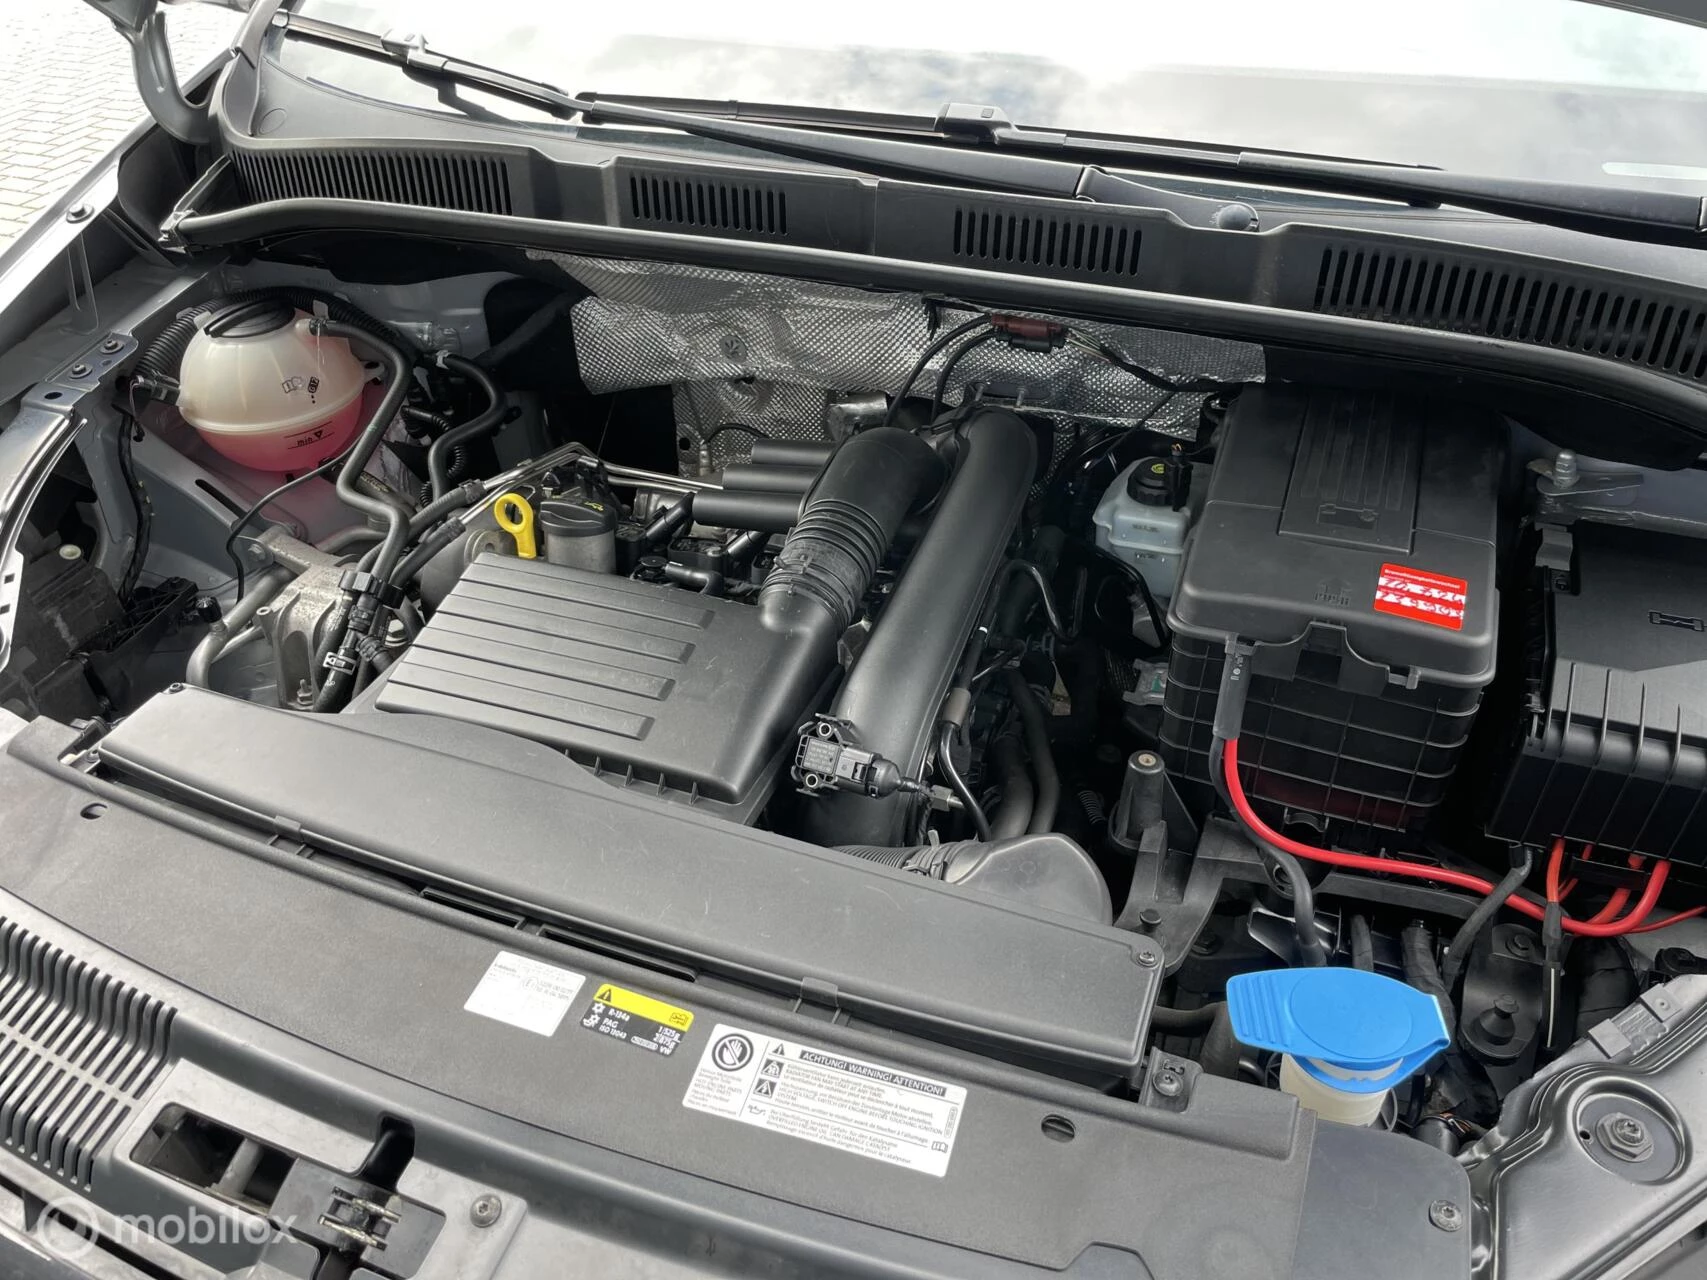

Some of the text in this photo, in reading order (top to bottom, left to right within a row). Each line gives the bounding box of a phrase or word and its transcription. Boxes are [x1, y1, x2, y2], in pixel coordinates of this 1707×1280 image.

[297, 437, 313, 447] min
[602, 1018, 619, 1028] PAG
[599, 1025, 610, 1033] ISO
[802, 1051, 847, 1070] ACHTUNG!
[847, 1063, 892, 1082] WARNING!
[893, 1075, 944, 1095] ATTENTION!
